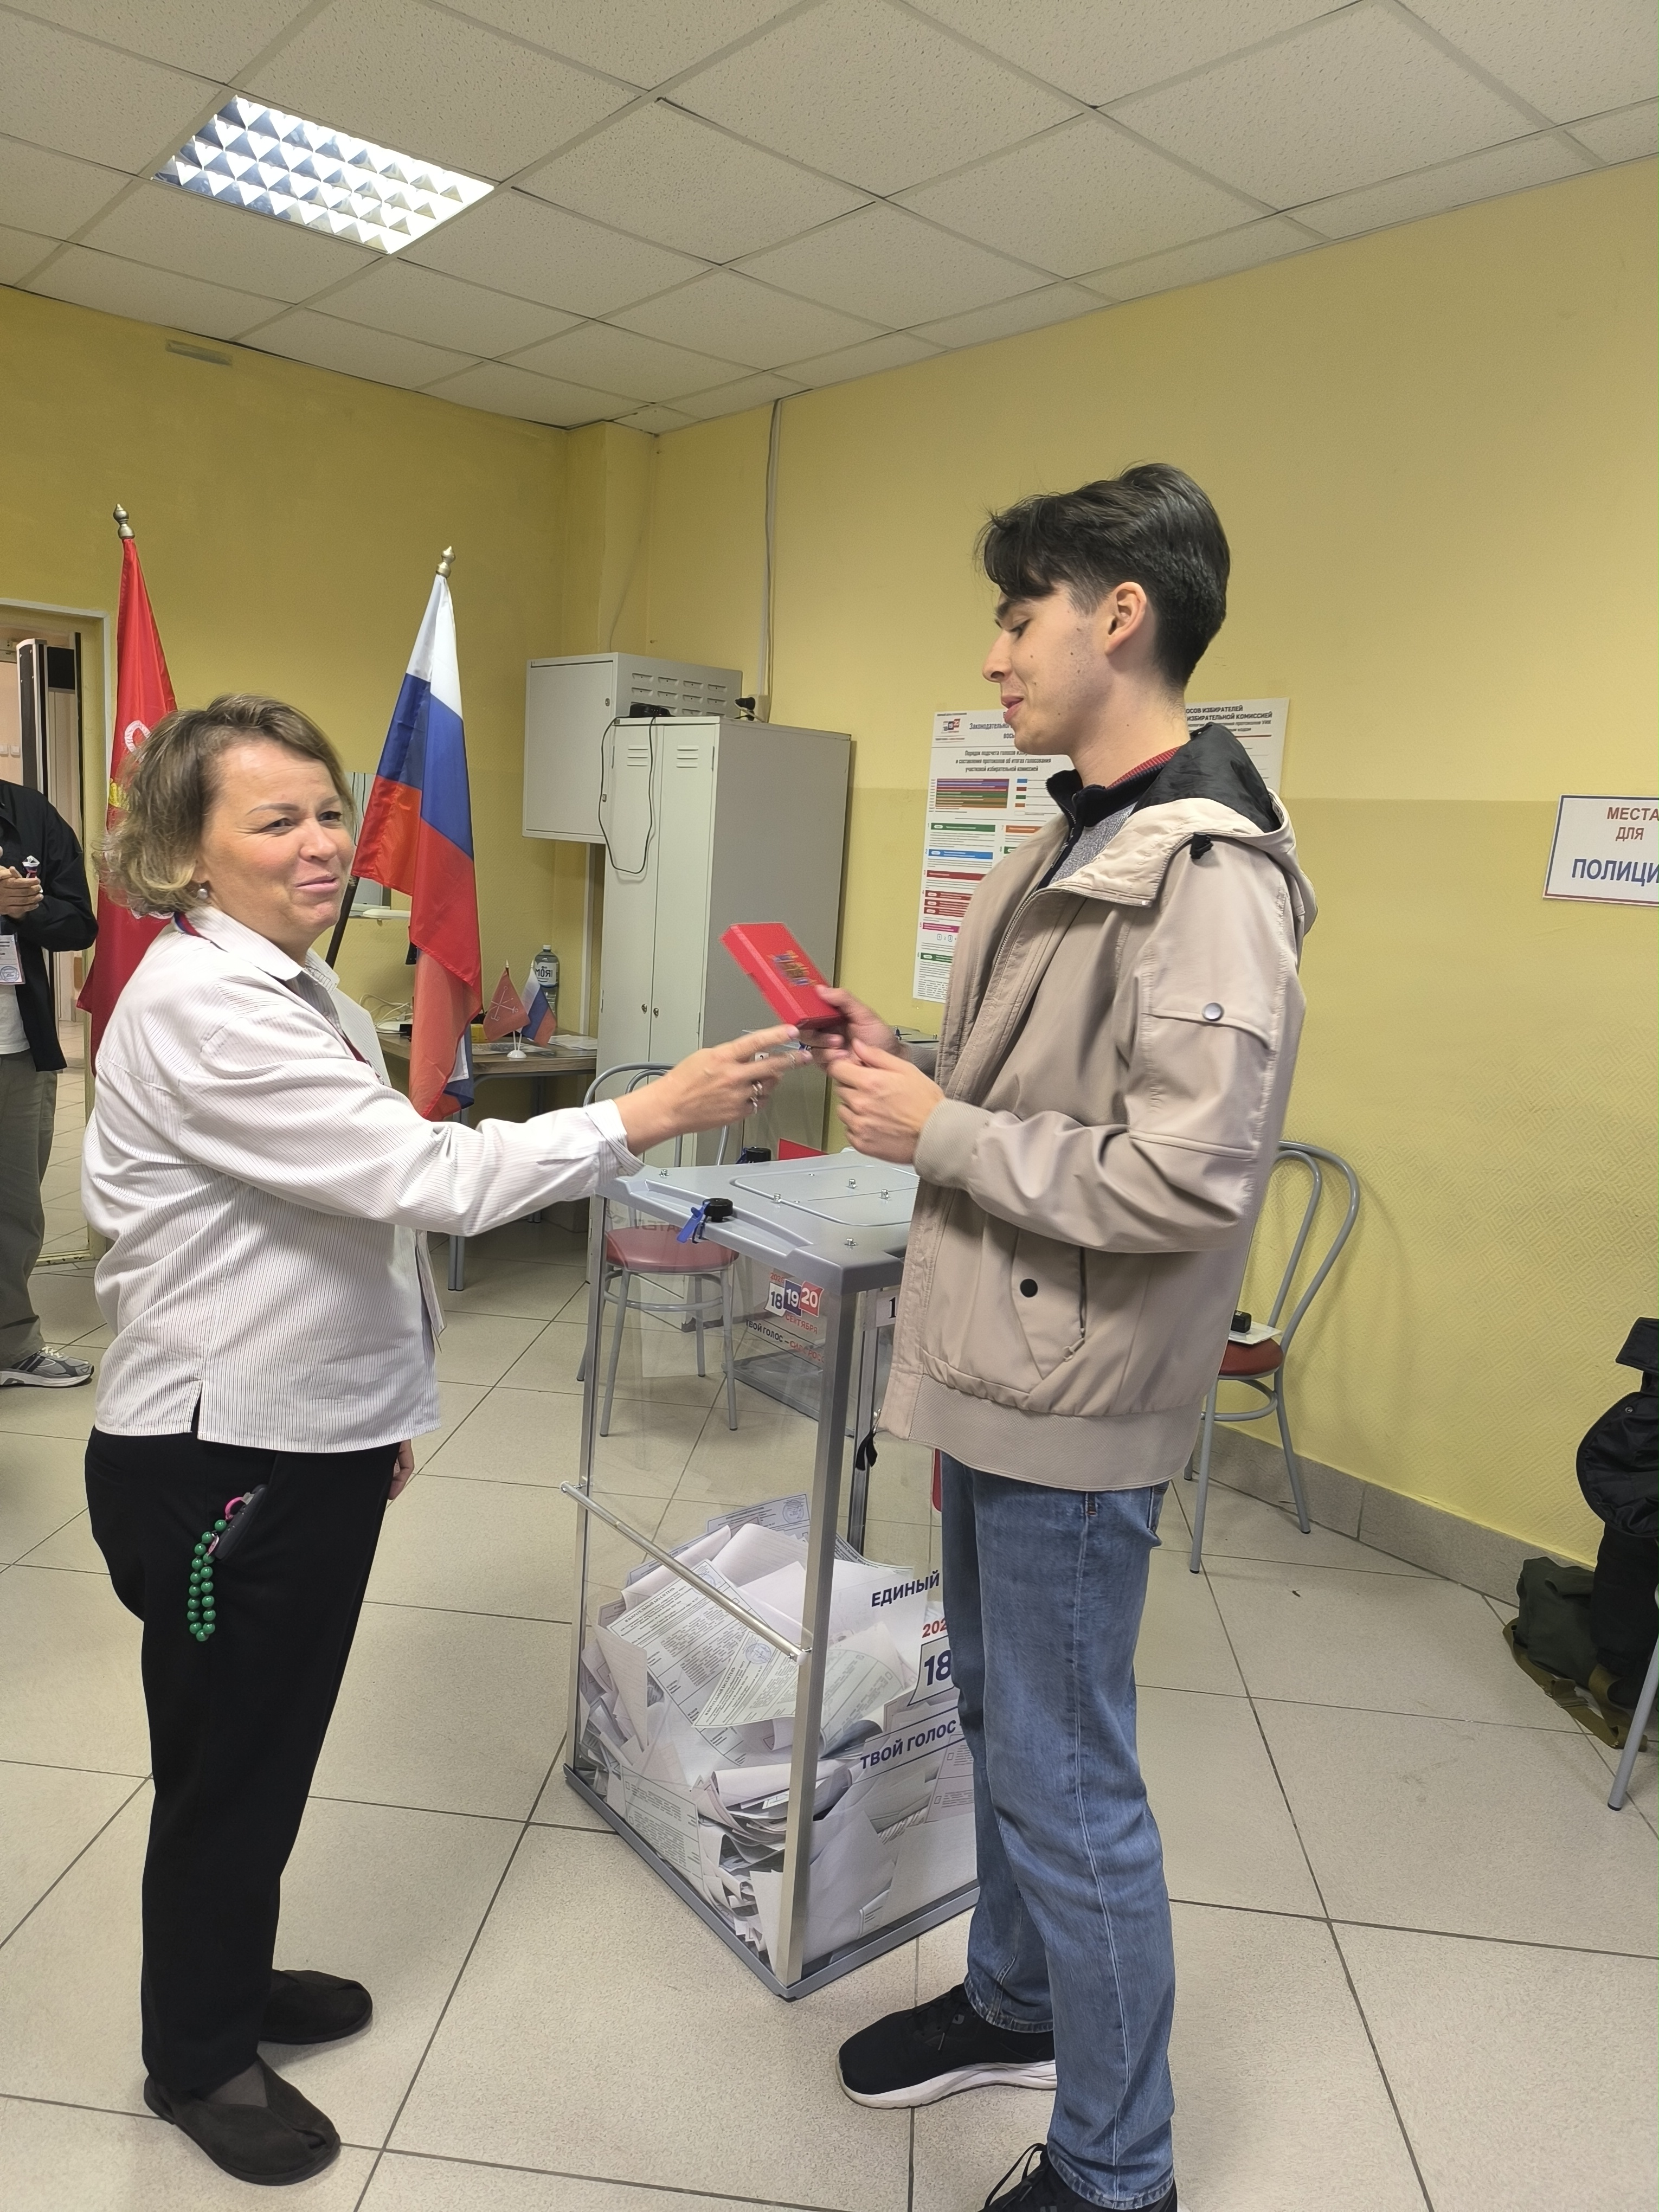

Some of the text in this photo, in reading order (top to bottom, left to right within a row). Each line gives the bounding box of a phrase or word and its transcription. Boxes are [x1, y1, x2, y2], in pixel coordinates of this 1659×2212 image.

[1187, 711, 1272, 721] ИЗБИРАТЕЛЬНОЙ КОМИССИЕЙ
[1202, 705, 1243, 713] ИЗБИРАТЕЛЕЙ
[1607, 807, 1659, 821] МЕСТА
[1616, 827, 1644, 841] ДЛЯ
[770, 1288, 818, 1310] 18 19 20
[745, 1319, 762, 1332] ТВОЙ
[763, 1327, 783, 1342] ГОЛОС
[786, 1314, 818, 1334] СЕНТЯБРЯ
[871, 1570, 940, 1607] ЕДИНЫЙ
[924, 1649, 951, 1686] 18
[860, 1720, 956, 1769] ТВОЙ ГОЛОС
